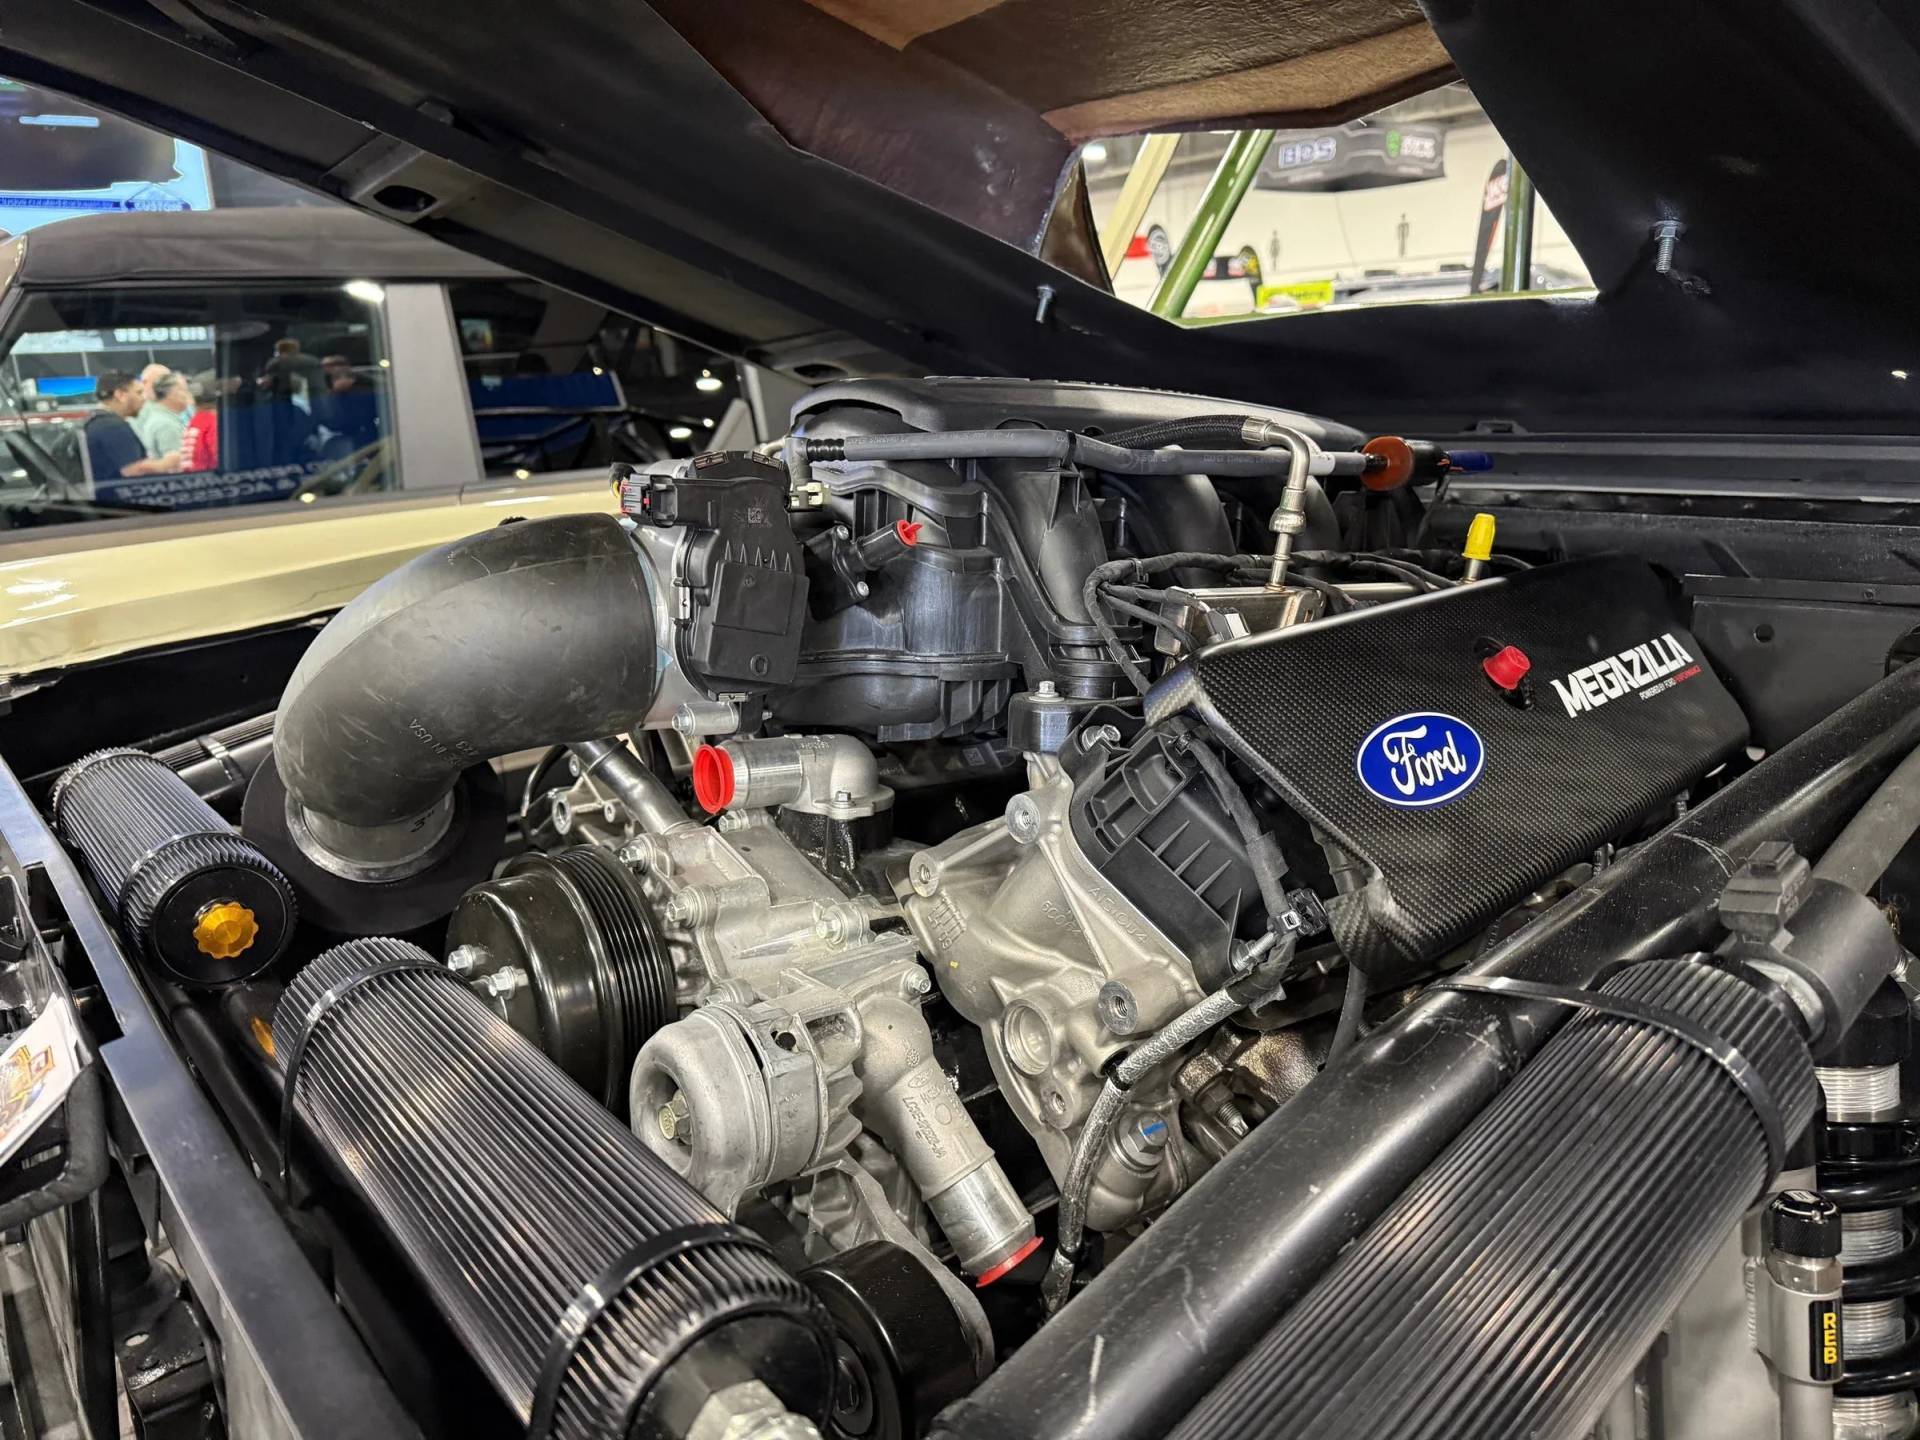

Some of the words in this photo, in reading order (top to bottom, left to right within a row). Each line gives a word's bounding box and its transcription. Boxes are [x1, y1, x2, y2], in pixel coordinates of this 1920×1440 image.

[1550, 633, 1694, 718] MEGAZILLA
[1639, 683, 1660, 700] POWERED
[1382, 724, 1467, 796] Ford
[1823, 1312, 1838, 1365] REB
